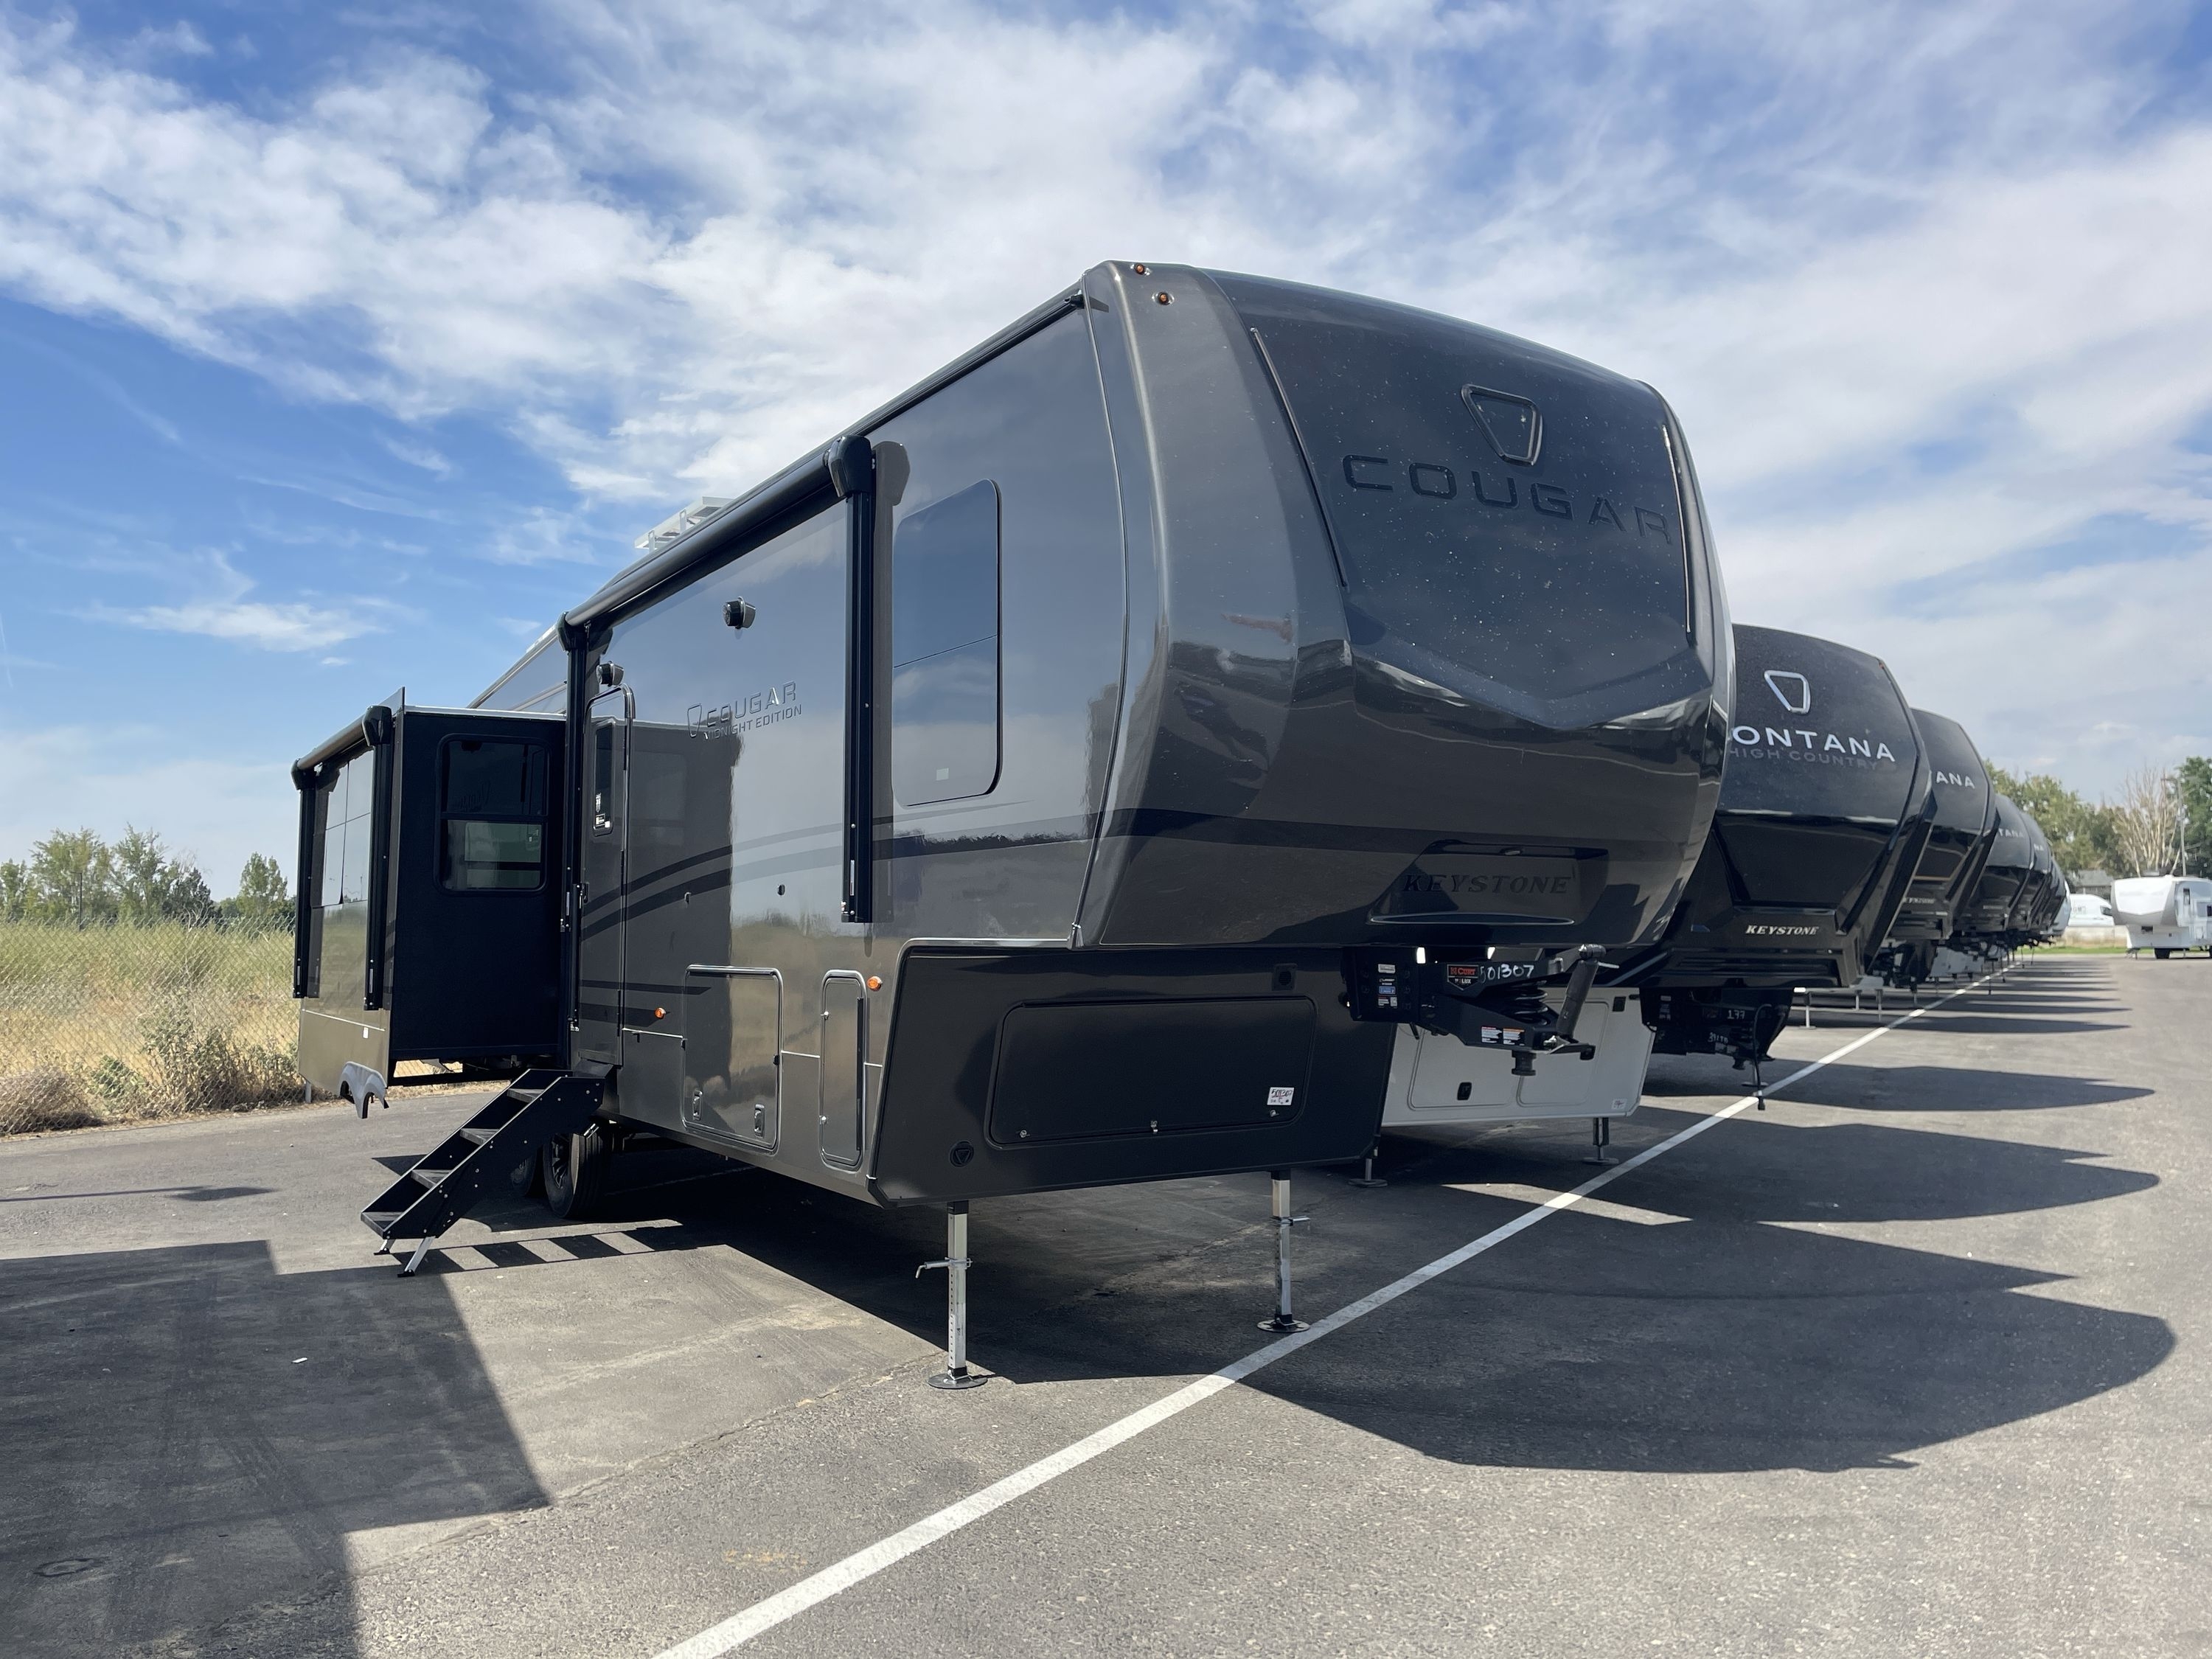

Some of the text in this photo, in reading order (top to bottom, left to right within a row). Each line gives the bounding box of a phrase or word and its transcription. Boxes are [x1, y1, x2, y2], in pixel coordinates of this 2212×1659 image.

[1343, 454, 1672, 544] COUGAR
[707, 681, 796, 727] COUGAR
[704, 704, 802, 740] MIDNIGHT EDITION
[1732, 726, 1896, 762] ONTANA
[1789, 750, 1878, 771] COUNTRY
[1401, 874, 1572, 894] KEYSTONE
[1745, 925, 1820, 936] KEYSTONE
[1480, 964, 1534, 984] 501307
